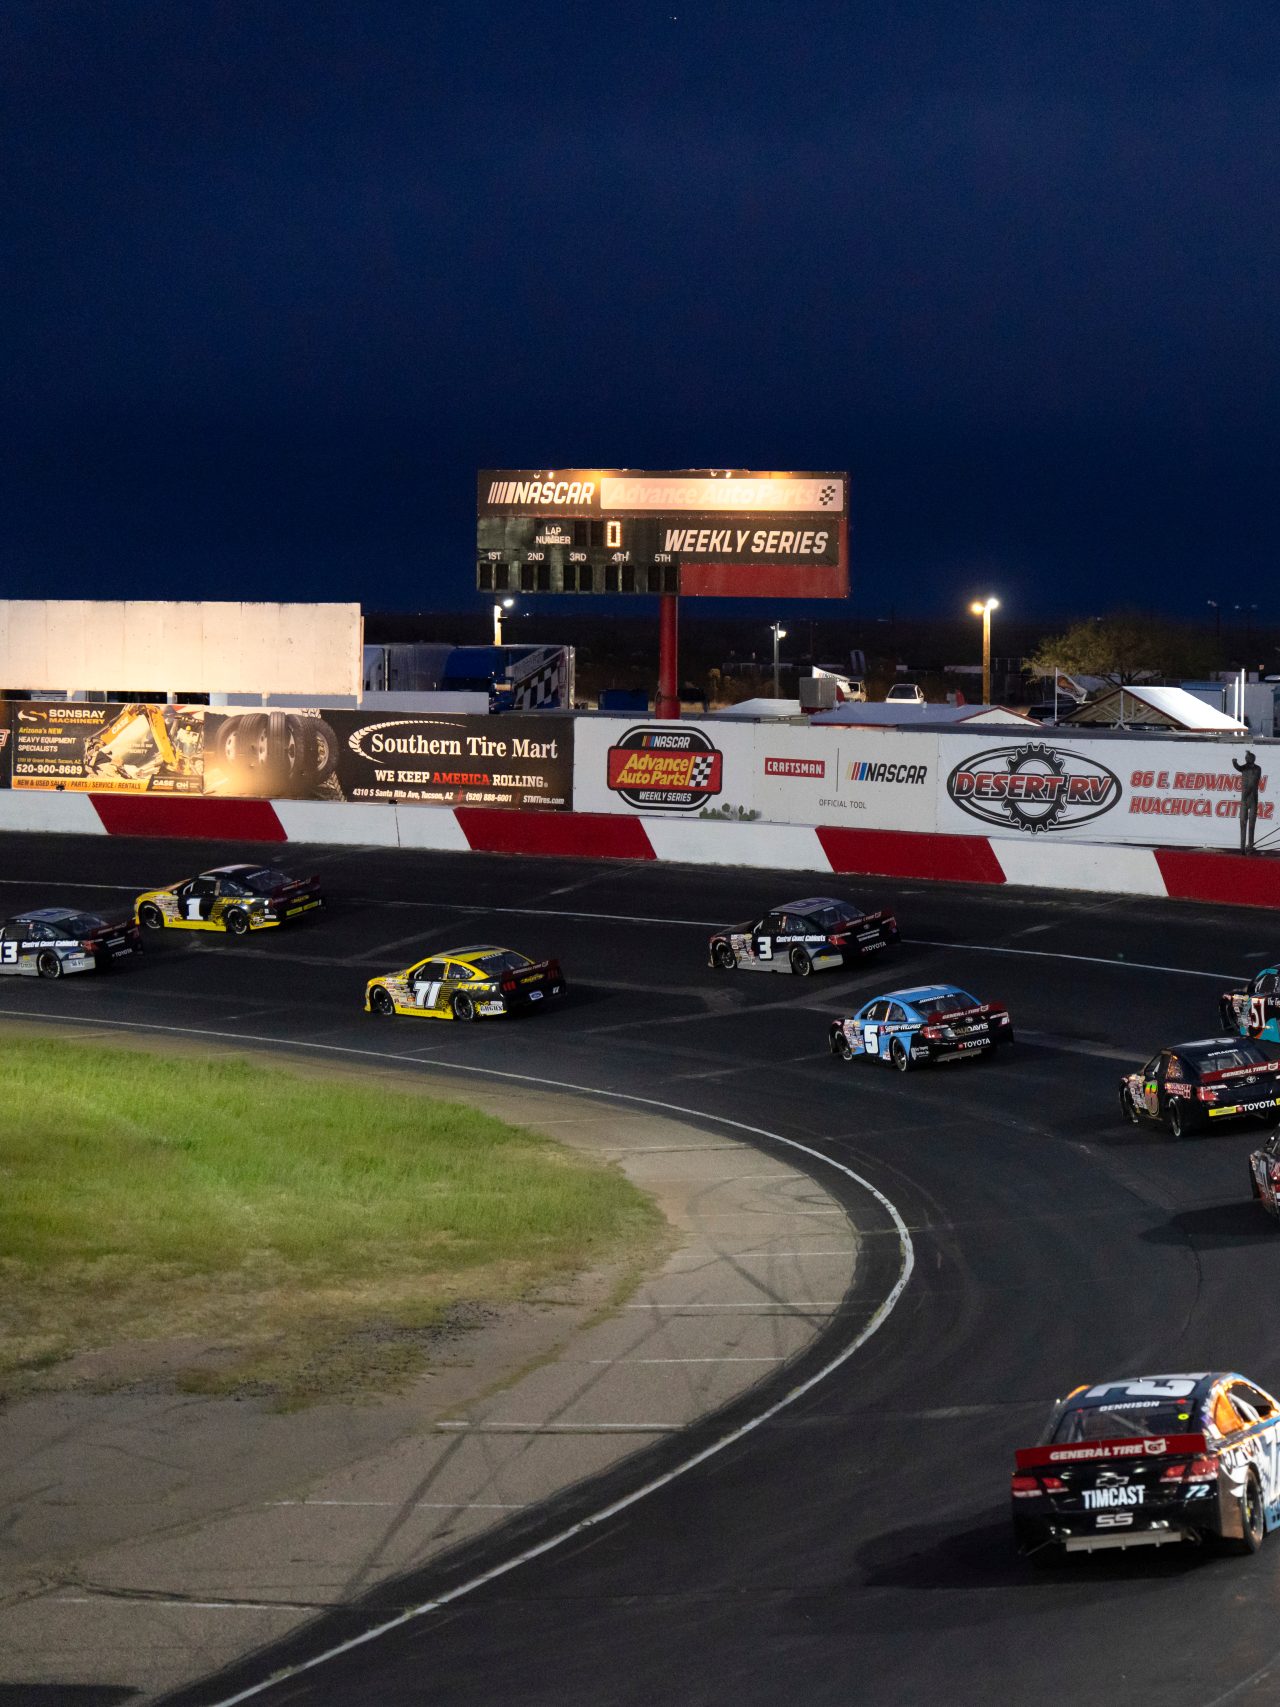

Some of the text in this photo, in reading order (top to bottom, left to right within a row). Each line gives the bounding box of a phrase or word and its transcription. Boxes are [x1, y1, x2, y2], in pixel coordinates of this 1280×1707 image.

[514, 481, 595, 505] NASCAR
[607, 484, 816, 505] Advance Auto Parts
[545, 526, 562, 536] LAP
[607, 521, 621, 548] 0
[535, 535, 571, 545] NUMBER
[664, 529, 829, 554] WEEKLY SERIES
[487, 552, 502, 560] 1ST
[527, 552, 545, 561] 2ND
[569, 552, 587, 562] 3RD
[611, 552, 629, 562] 4TH
[654, 553, 672, 562] 5TH
[48, 709, 106, 719] SONSRAY
[18, 727, 63, 735] Arizona's NEW
[18, 736, 40, 744] HEAVY
[40, 736, 77, 745] EQUIPMENT
[371, 733, 559, 760] Southern Tire Mart
[653, 735, 691, 749] NASCAR
[17, 745, 58, 753] SPECIALISTS
[16, 763, 83, 775] 520-900-8689
[624, 753, 690, 772] Advance
[767, 760, 825, 776] CRAFTSMAN
[374, 769, 395, 783] WE
[397, 770, 431, 784] KEEP
[432, 772, 490, 786] AMERICA
[616, 768, 687, 786] Auto Parts
[863, 763, 928, 785] NASCAR
[1129, 769, 1155, 789] 86
[1156, 770, 1170, 790] E.
[17, 779, 29, 787] NEW
[36, 780, 50, 788] USED
[70, 780, 87, 788] PARTS
[92, 781, 114, 789] SERVICE
[118, 782, 141, 790] RENTALS
[953, 771, 1113, 803] DESERT RV
[352, 788, 369, 797] 4310
[374, 788, 393, 798] Santa
[393, 789, 407, 798] Rita
[420, 790, 444, 801] Tucson,
[445, 791, 454, 800] AZ
[465, 792, 483, 802] (520)
[639, 791, 692, 802] WEEKLY SERIES
[818, 798, 867, 810] OFFICIAL TOOL
[1129, 795, 1213, 819] HUACHUCA
[1215, 799, 1245, 819] CIT
[186, 897, 204, 921] 1
[757, 936, 773, 960] 3
[864, 941, 887, 952] TOYOTA
[412, 980, 444, 1009] 71
[968, 1021, 989, 1032] DAVIS
[863, 1024, 879, 1054] 5
[962, 1037, 991, 1049] TOYOTA
[1221, 1065, 1268, 1078] GENERAL TIRE
[1242, 1099, 1277, 1112] TOYOTA
[1098, 1400, 1161, 1412] DENNISON
[1049, 1447, 1112, 1461] GENERAL
[1113, 1443, 1144, 1456] TIRE
[1081, 1485, 1146, 1510] TIMCAST
[1184, 1485, 1211, 1499] 72
[1095, 1512, 1134, 1528] SS
